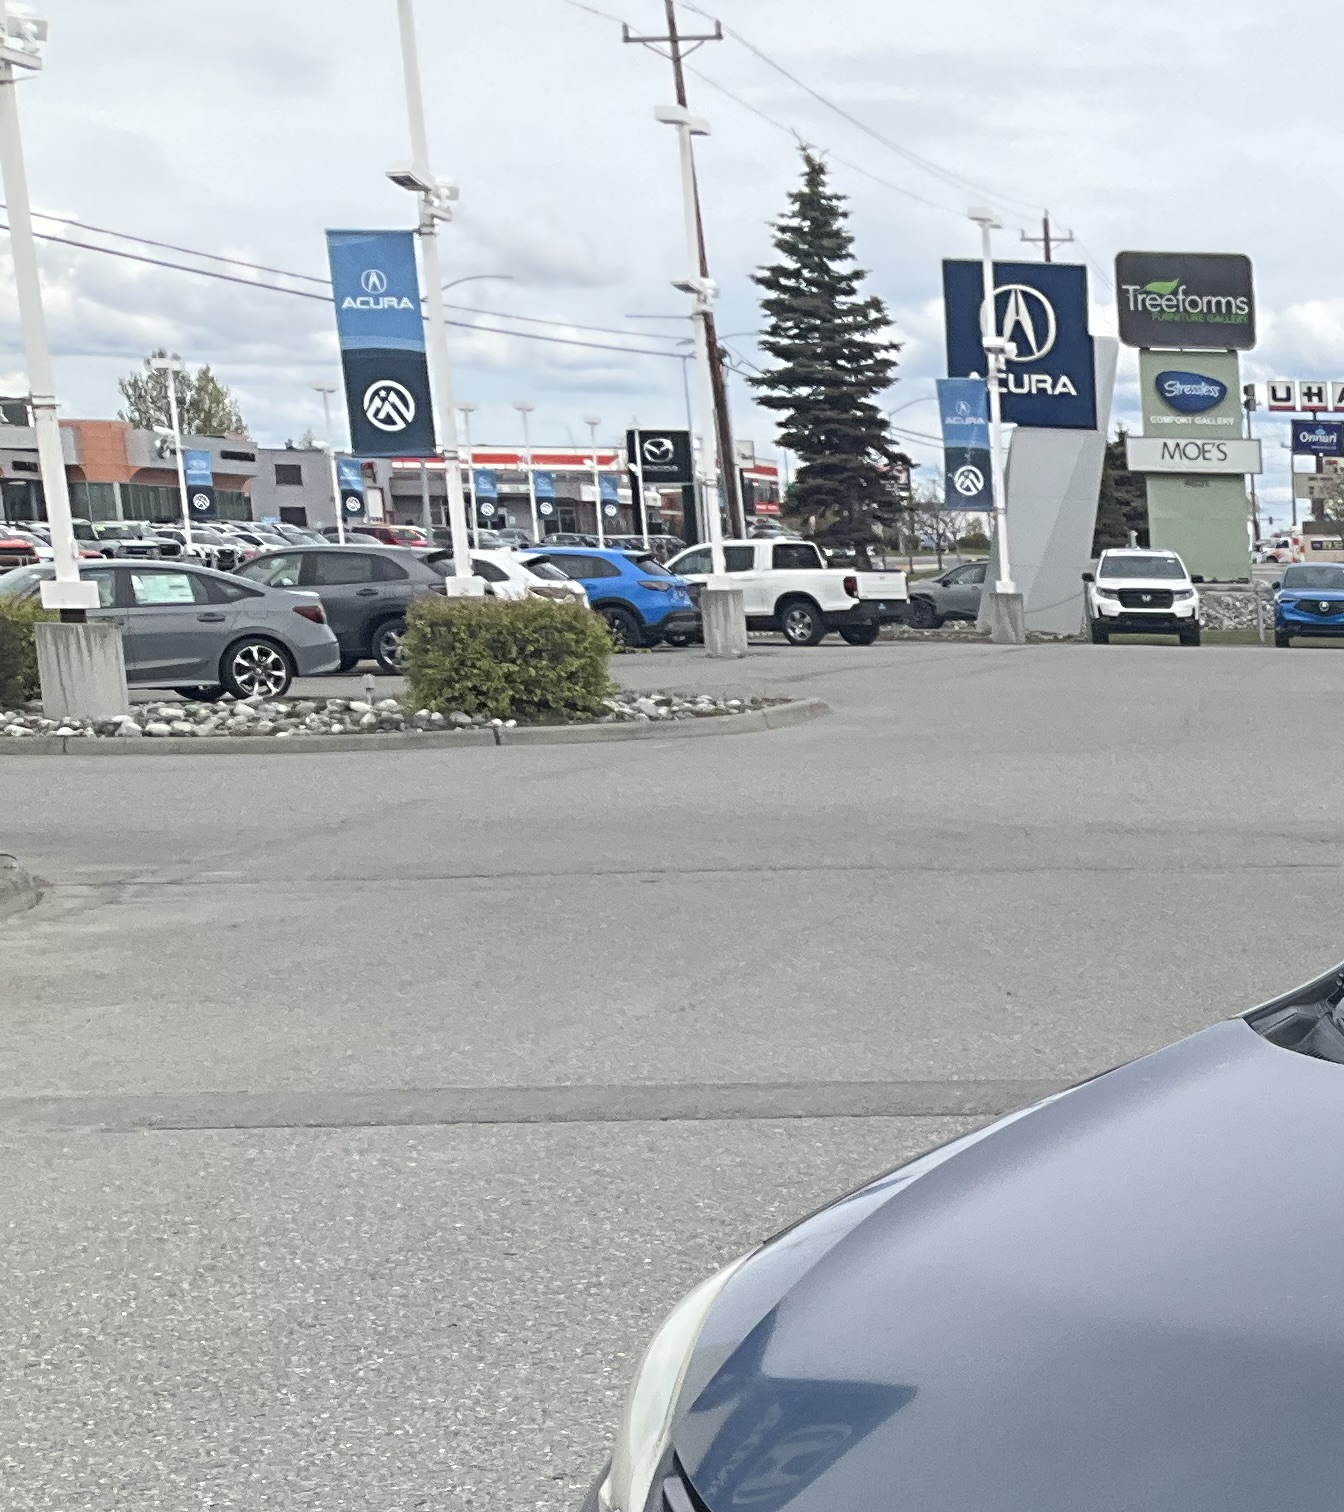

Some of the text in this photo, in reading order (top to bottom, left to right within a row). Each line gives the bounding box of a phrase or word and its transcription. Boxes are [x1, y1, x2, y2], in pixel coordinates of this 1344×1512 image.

[341, 296, 415, 310] ACURA
[1121, 285, 1249, 315] Treeforms
[1163, 380, 1222, 398] Stressless
[944, 416, 987, 425] ACURA
[1161, 441, 1228, 461] MOE'S
